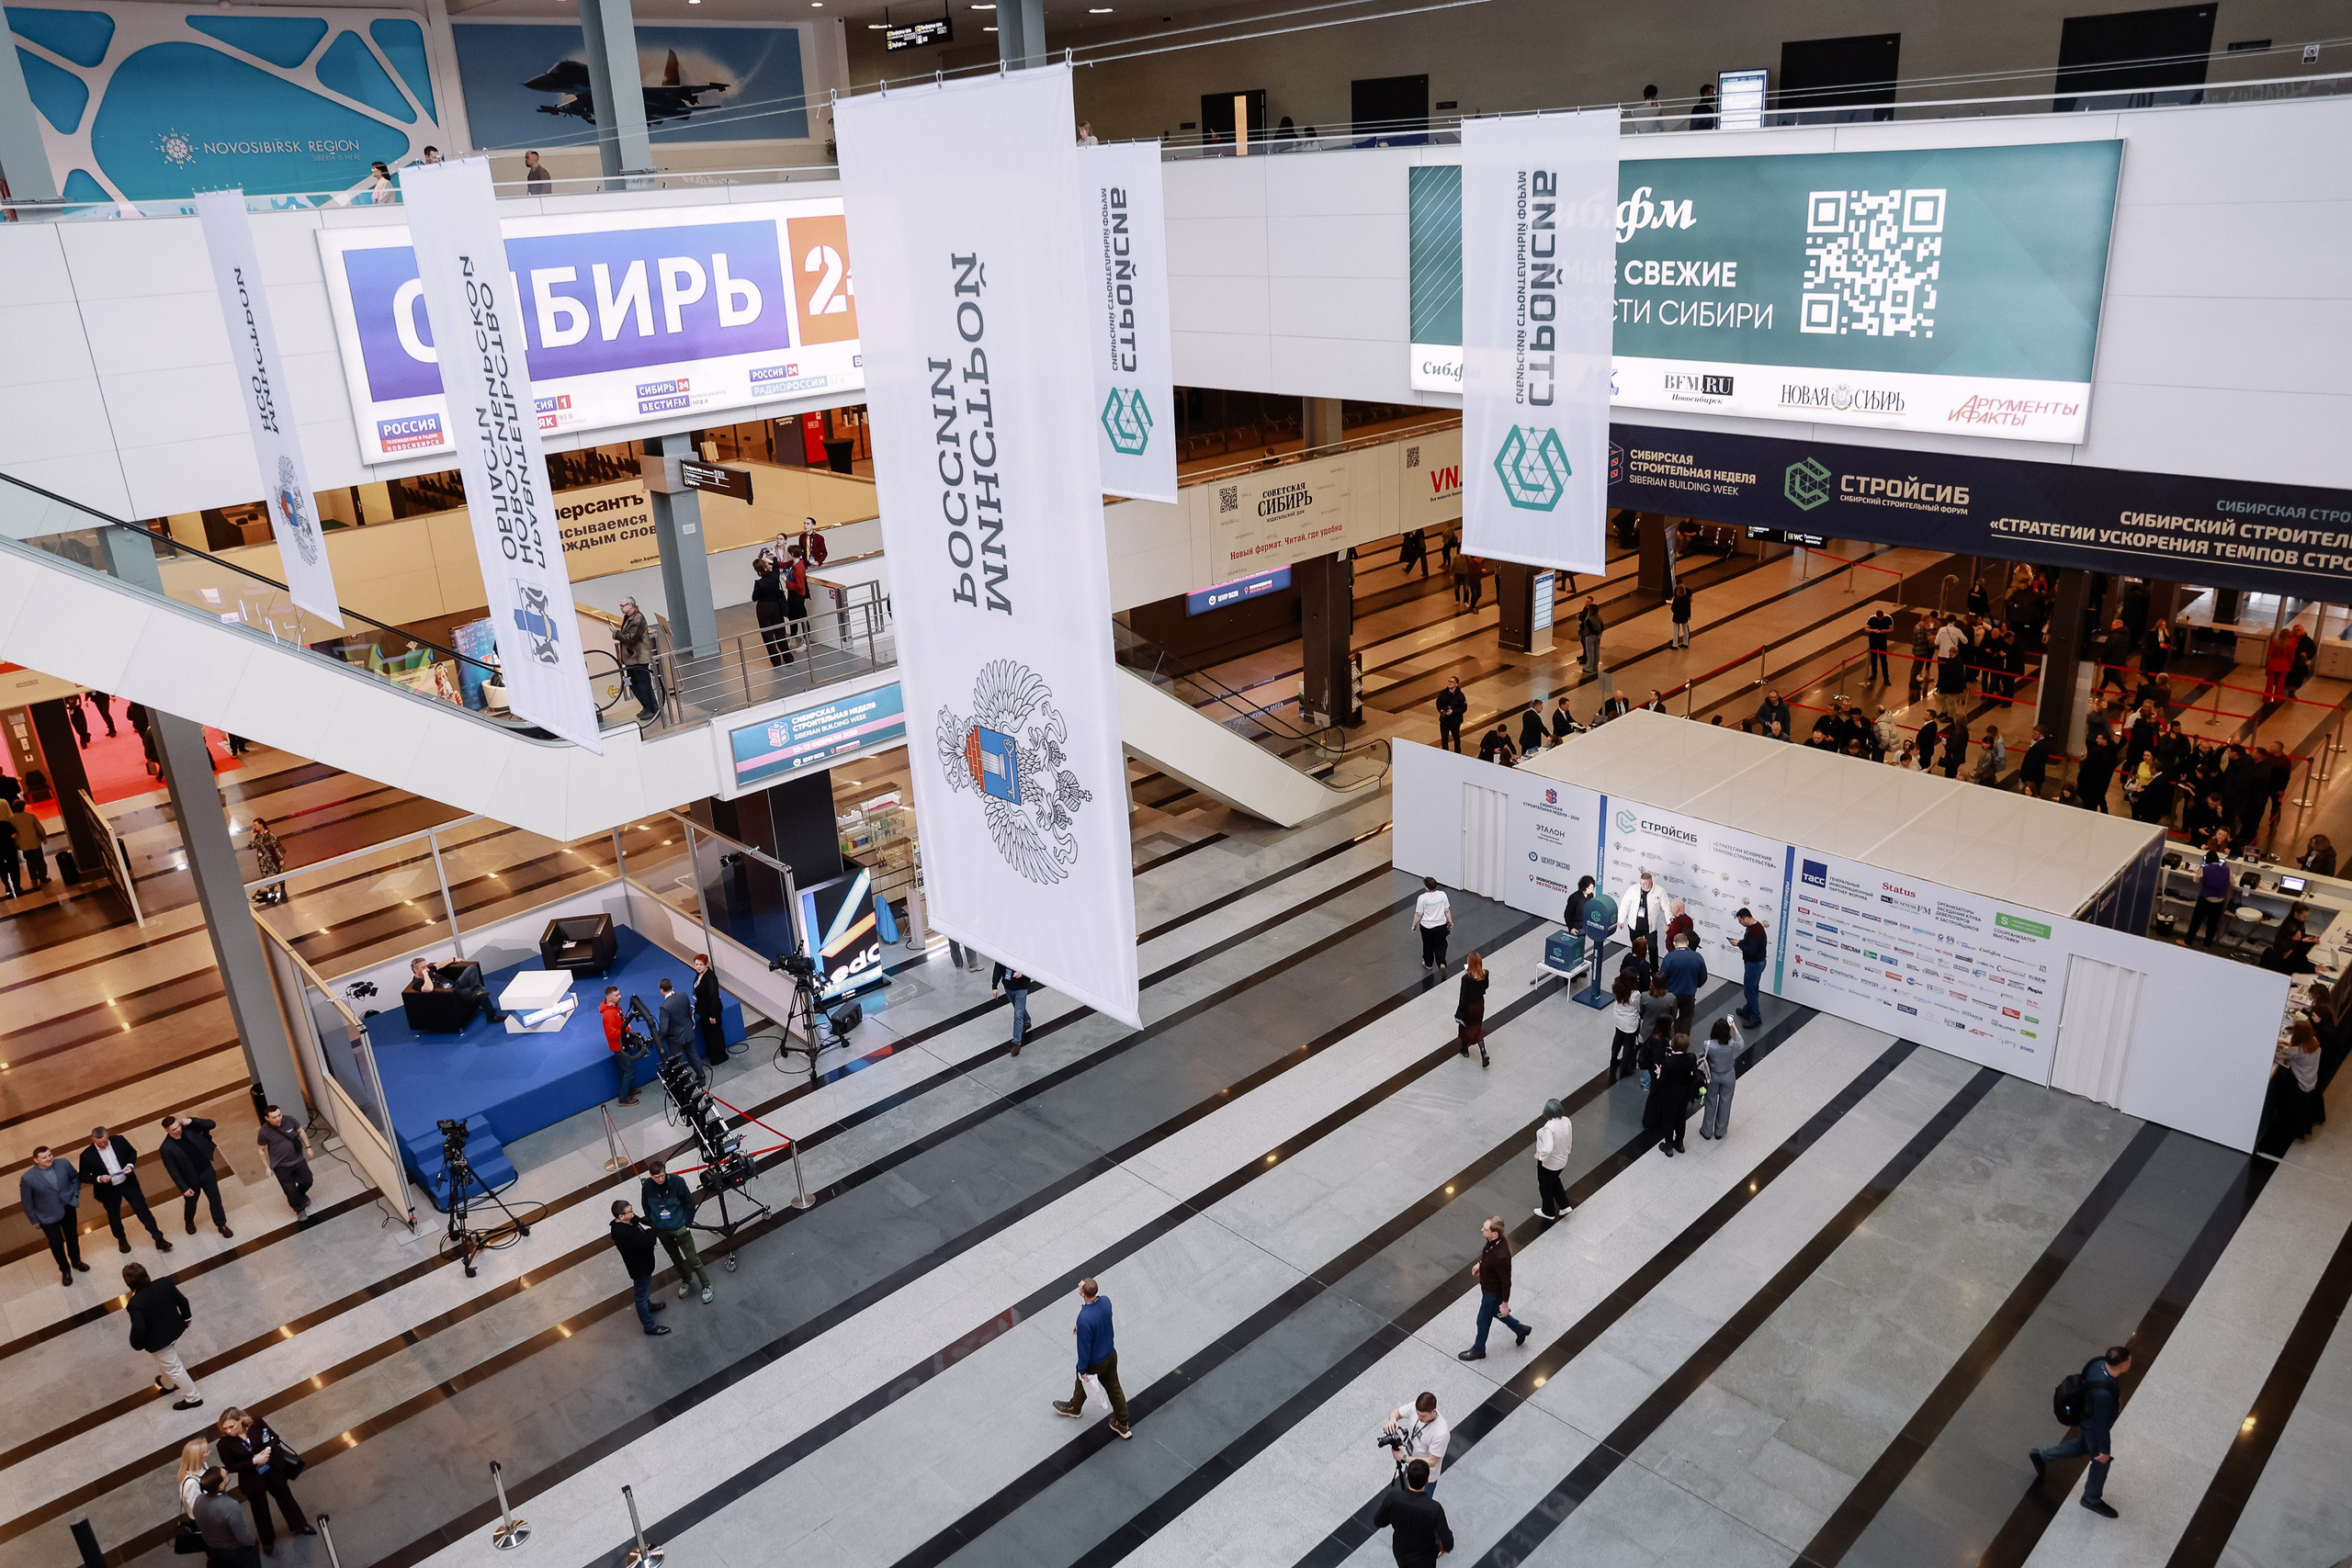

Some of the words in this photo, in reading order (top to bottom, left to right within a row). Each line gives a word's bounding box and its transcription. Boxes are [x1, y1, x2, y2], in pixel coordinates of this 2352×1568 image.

[203, 139, 302, 155] NOVOSIBIRSK
[308, 140, 360, 155] REGION
[1624, 260, 1737, 288] СВЕЖИЕ
[392, 253, 763, 365] СБИРЬ
[804, 245, 854, 316] 2
[1658, 299, 1773, 330] СИБИРИ
[752, 367, 784, 380] РОССИЯ
[787, 366, 797, 376] 24
[639, 382, 675, 397] СИБИРЬ
[678, 380, 689, 390] 24
[1665, 374, 1734, 395] BFM.RU
[1671, 393, 1724, 405] Новосибирск
[1781, 384, 1829, 406] НОВАЯ
[1854, 389, 1905, 412] СИБИРЬ
[1958, 394, 2080, 416] АРГУМЕНТЫ
[382, 418, 437, 436] РОССИЯ
[386, 435, 419, 445] ТЕЛЕВИДЕНИЕ
[387, 439, 440, 452] НОВОСИБИРСК
[1630, 449, 1693, 466] СИБИРСКАЯ
[1630, 461, 1712, 479] СТРОИТЕЛЬНАЯ
[1713, 470, 1757, 485] НЕДЕЛЯ
[1262, 481, 1306, 499] СОВЕТСКАЯ
[1629, 474, 1668, 488] SIBERIAN
[1668, 479, 1711, 493] BUILDING
[1713, 484, 1739, 496] WEEK
[1840, 475, 1970, 505] СТРОЙСИБ
[1258, 490, 1313, 517] СИБИРЬ
[1839, 494, 1882, 505] СИБИРСКИЙ
[1882, 499, 1939, 513] СТРОИТЕЛЬНЫЙ
[1939, 506, 1968, 515] ФОРУМ
[2216, 500, 2306, 519] СИБИРСКАЯ
[2310, 508, 2352, 525] СТРО
[2120, 511, 2236, 536] СИБИРСКИЙ
[2239, 524, 2352, 549] СТРОИТЕЛ
[1230, 547, 1254, 560] Новый
[1307, 528, 1319, 540] где
[1319, 523, 1343, 537] удобно
[1989, 517, 2096, 541] «СТРАТЕГИИ
[2099, 528, 2210, 555] УСКОРЕНИЯ
[2212, 539, 2300, 565] ТЕМПОВ
[791, 706, 836, 725] СИБИРСКАЯ
[792, 710, 849, 732] СТРОИТЕЛЬНАЯ
[849, 702, 876, 716] НЕДЕЛЯ
[794, 727, 821, 740] SIBERIAN
[821, 718, 851, 733] BUILDING
[850, 713, 867, 724] WEEK
[811, 734, 842, 748] ФЕВРАЛЯ
[1539, 802, 1563, 811] СИБИРСКАЯ
[1535, 824, 1566, 838] ЭТАЛОН
[1641, 820, 1698, 843] СТРОЙСИБ
[1713, 847, 1734, 857] ТЕМПОВ
[1743, 850, 1772, 862] УСКОРЕНИЯ
[1541, 855, 1555, 867] ЦЕНТР
[1555, 860, 1570, 871] ЭКСПО
[1829, 876, 1860, 888] ГЕНЕРАЛЬНЫЙ
[1829, 881, 1873, 897] ИНФОРМАЦИОННЫЙ
[1882, 882, 1917, 898] Status
[1782, 881, 1791, 910] партнеры
[1828, 886, 1848, 895] ПАРТНЕР
[1848, 891, 1868, 901] ФОРУМА
[1917, 905, 1931, 915] FM
[1937, 901, 1975, 915] ОРГАНИЗАТОРЫ
[1937, 906, 1965, 918] ЗАСЕДАНИЯ
[1965, 914, 1982, 922] КЛУБА
[1935, 910, 1970, 924] ДЕВЕЛОПЕРОВ
[1939, 918, 1979, 932] ЗАСТРОЙЩИКОВ
[1993, 928, 2036, 942] СООРГАНИЗАТОР
[1993, 933, 2019, 943] ВЫСТАВКИ
